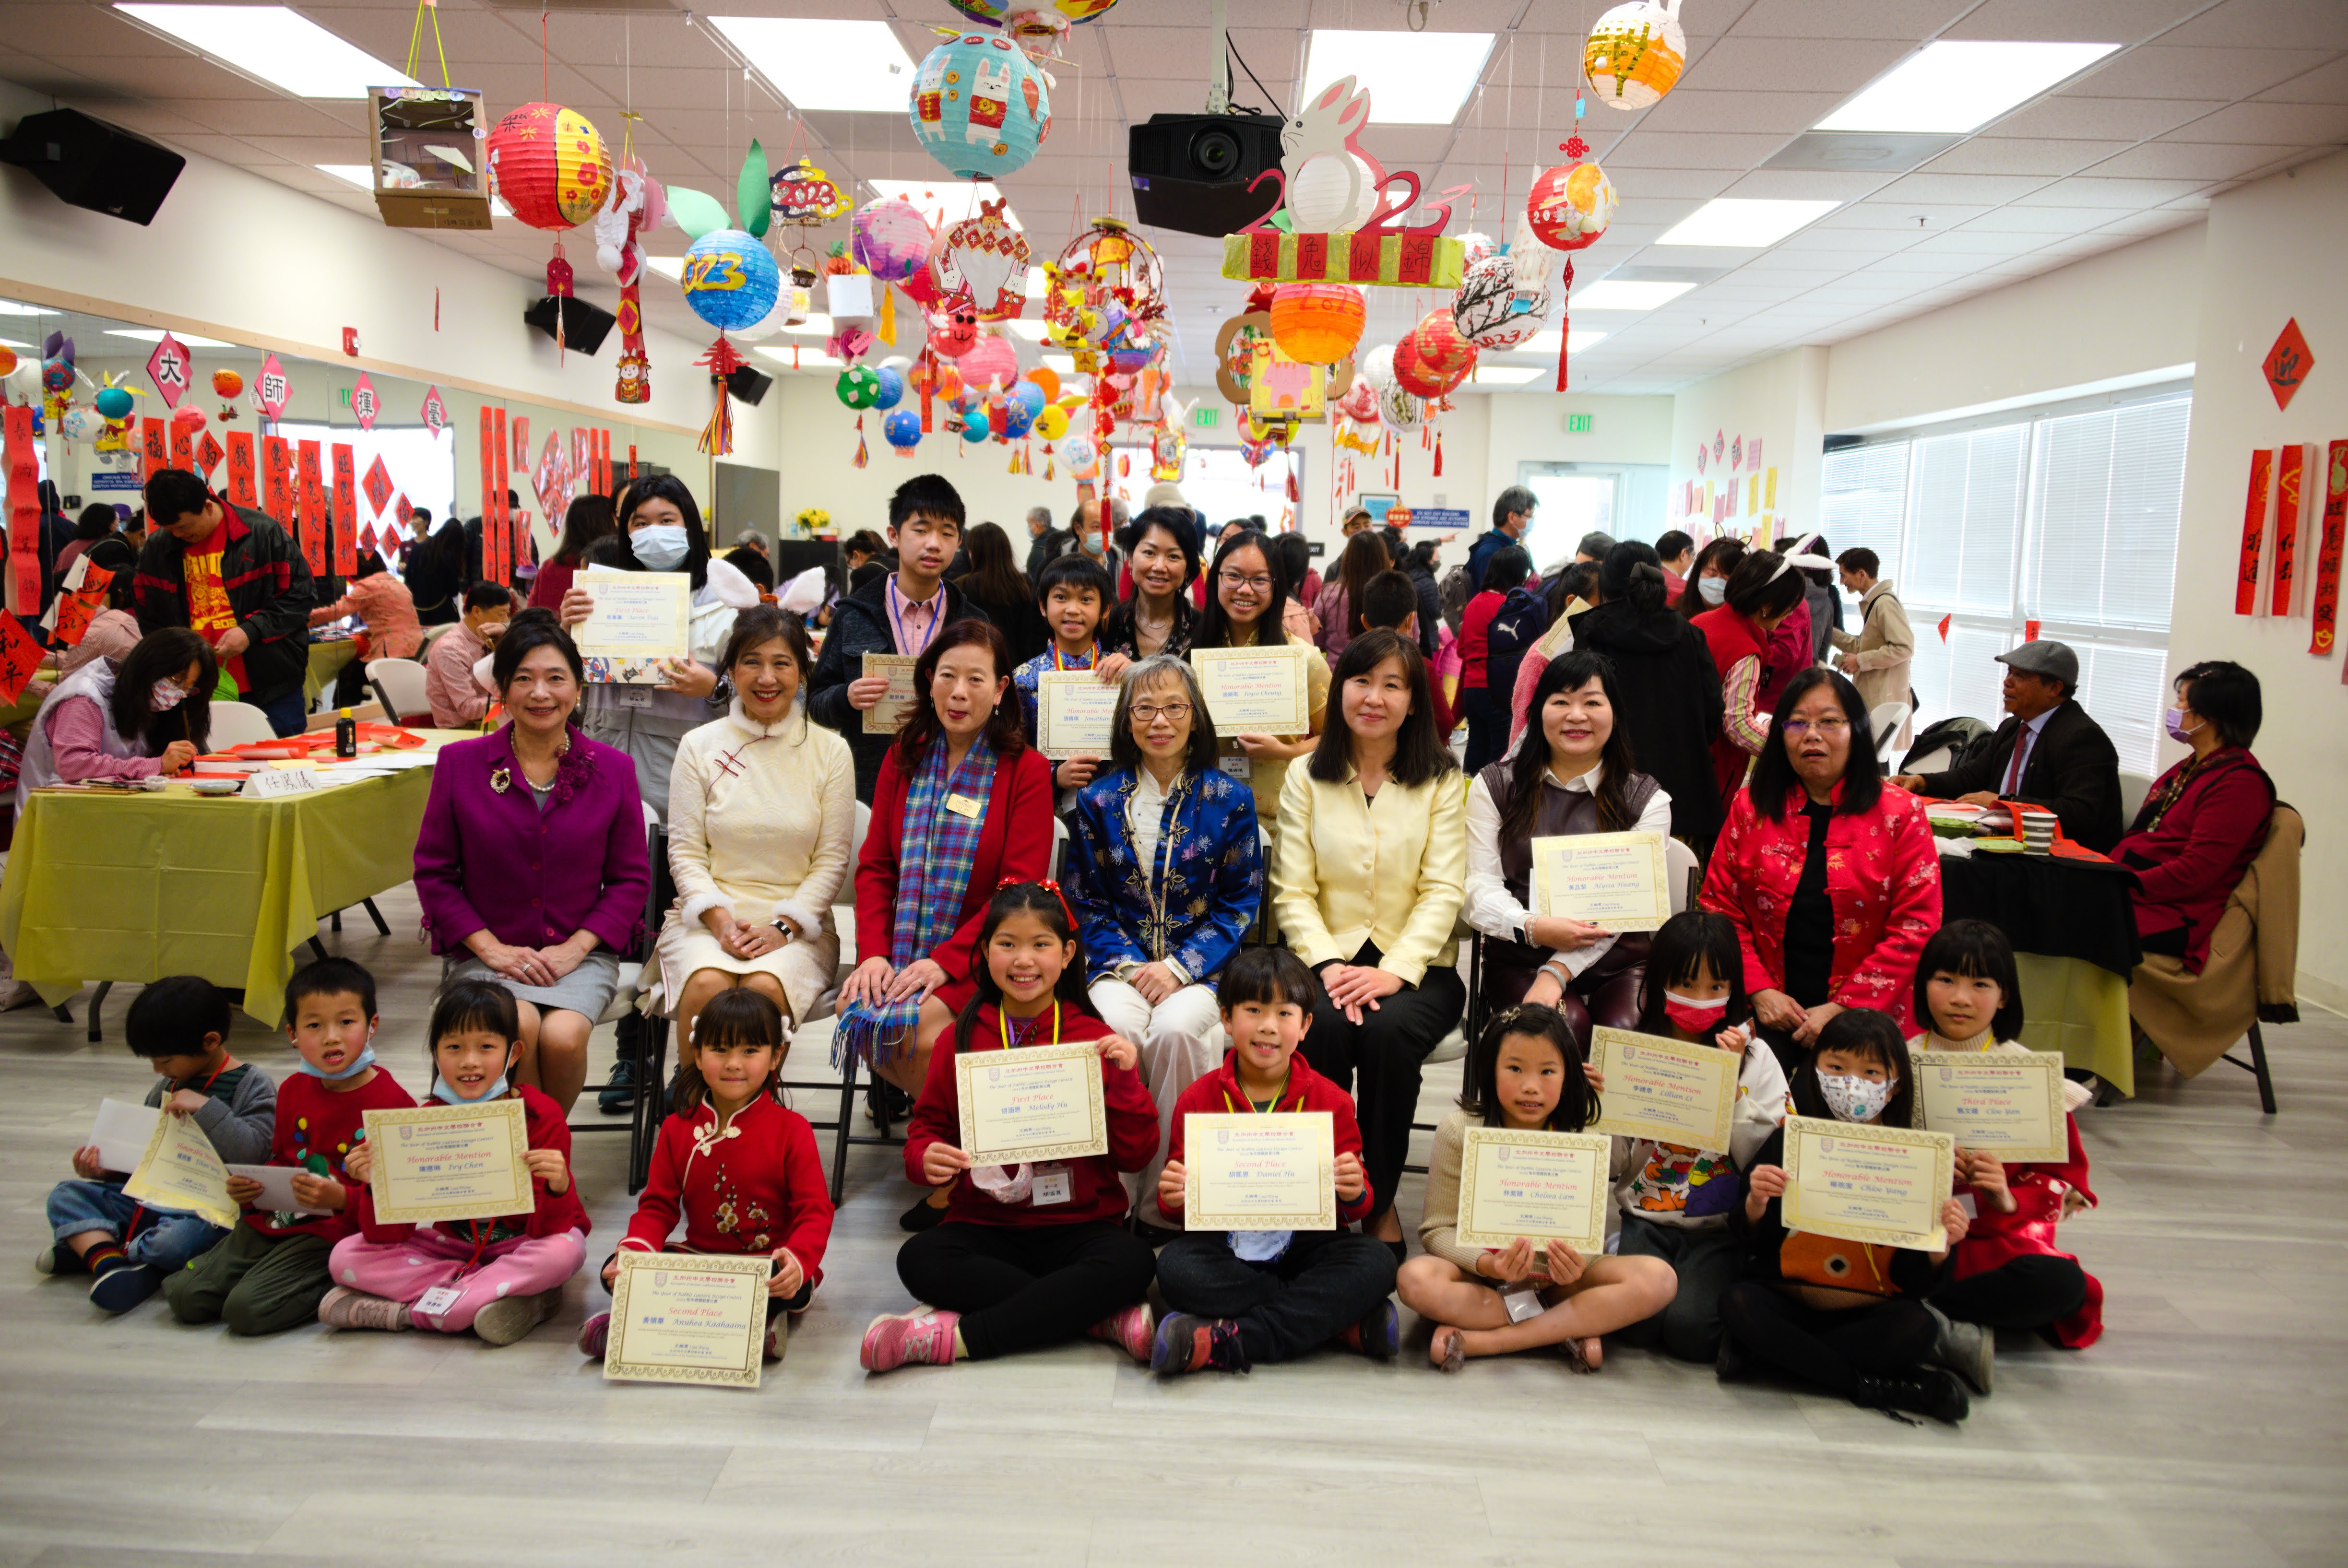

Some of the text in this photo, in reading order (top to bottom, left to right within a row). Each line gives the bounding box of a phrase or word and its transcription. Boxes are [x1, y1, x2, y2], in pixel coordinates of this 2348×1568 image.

[1252, 237, 1430, 279] 錢兔似錦
[681, 252, 747, 294] 023
[161, 353, 441, 425] 大 師 揮 毫
[1197, 409, 1217, 425] EXIT
[1569, 414, 1592, 431] EXIT
[146, 430, 163, 460] 福
[175, 436, 190, 455] 心
[1566, 874, 1604, 883] Honorable
[1592, 882, 1615, 890] Alyssa
[1616, 881, 1639, 889] Huang
[1005, 1063, 1063, 1073] 北加州中文學校聯合會
[1623, 1073, 1701, 1096] Honorable Mention
[1010, 1092, 1054, 1105] First Place
[1659, 1089, 1684, 1100] Lillian
[1028, 1102, 1055, 1113] Melody
[406, 1150, 492, 1164] Honorable Mention
[1515, 1149, 1574, 1158] 北加州中文學校聯合會
[447, 1163, 462, 1171] Ivy
[1822, 1169, 1912, 1187] Honorable Mention
[1498, 1179, 1578, 1191] Honorable Mention
[1530, 1191, 1556, 1200] Chelsea
[673, 1275, 736, 1284] 北加州中文學校聯合會
[668, 1307, 723, 1317] Second Place
[671, 1318, 703, 1327] Anuhea
